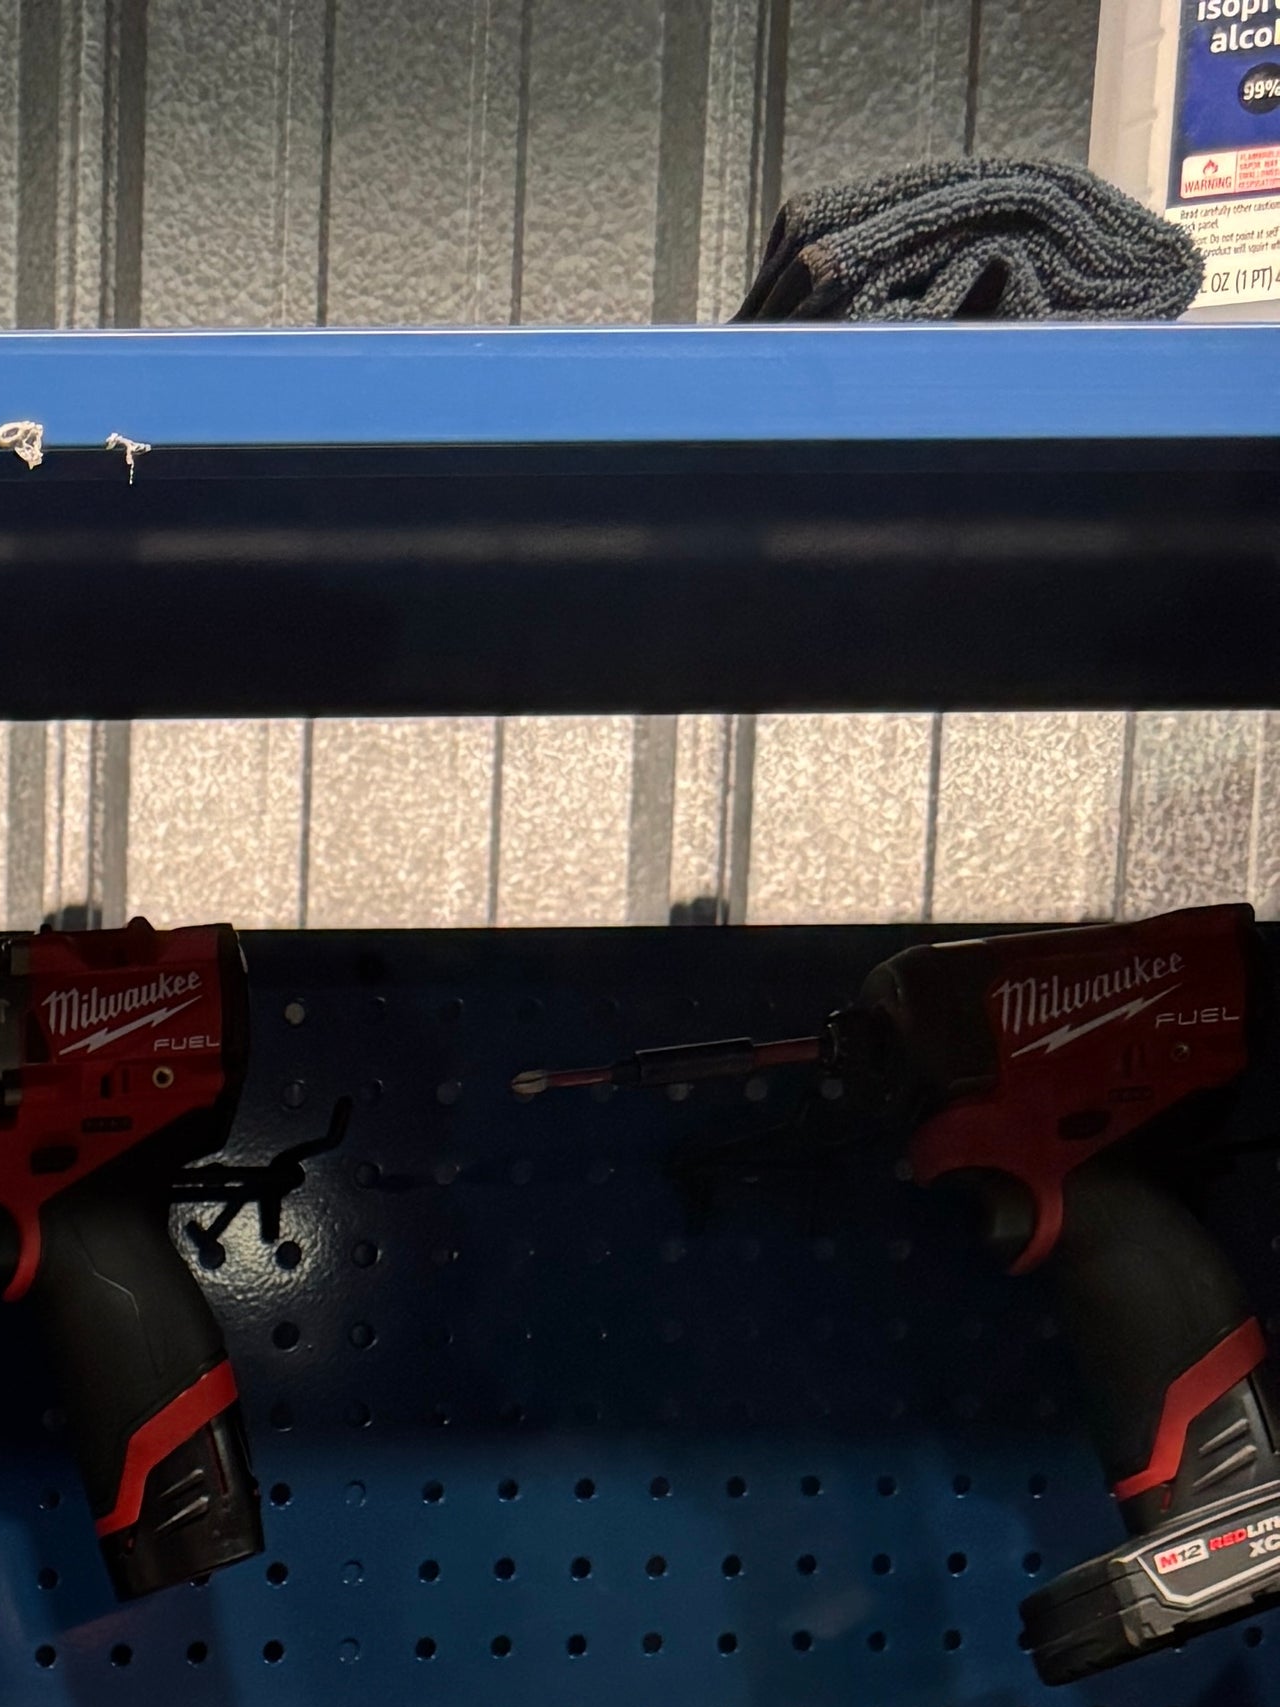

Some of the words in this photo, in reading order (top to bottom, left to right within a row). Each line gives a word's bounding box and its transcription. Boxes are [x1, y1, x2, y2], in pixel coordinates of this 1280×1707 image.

[1185, 176, 1232, 193] WARNING
[1211, 271, 1230, 293] OZ
[1251, 265, 1273, 291] PT)
[992, 953, 1185, 1034] Milwaukee
[1154, 1007, 1240, 1028] FUEL
[41, 971, 203, 1037] Milwaukee
[153, 1034, 221, 1052] FUEL
[1160, 1543, 1203, 1569] M12
